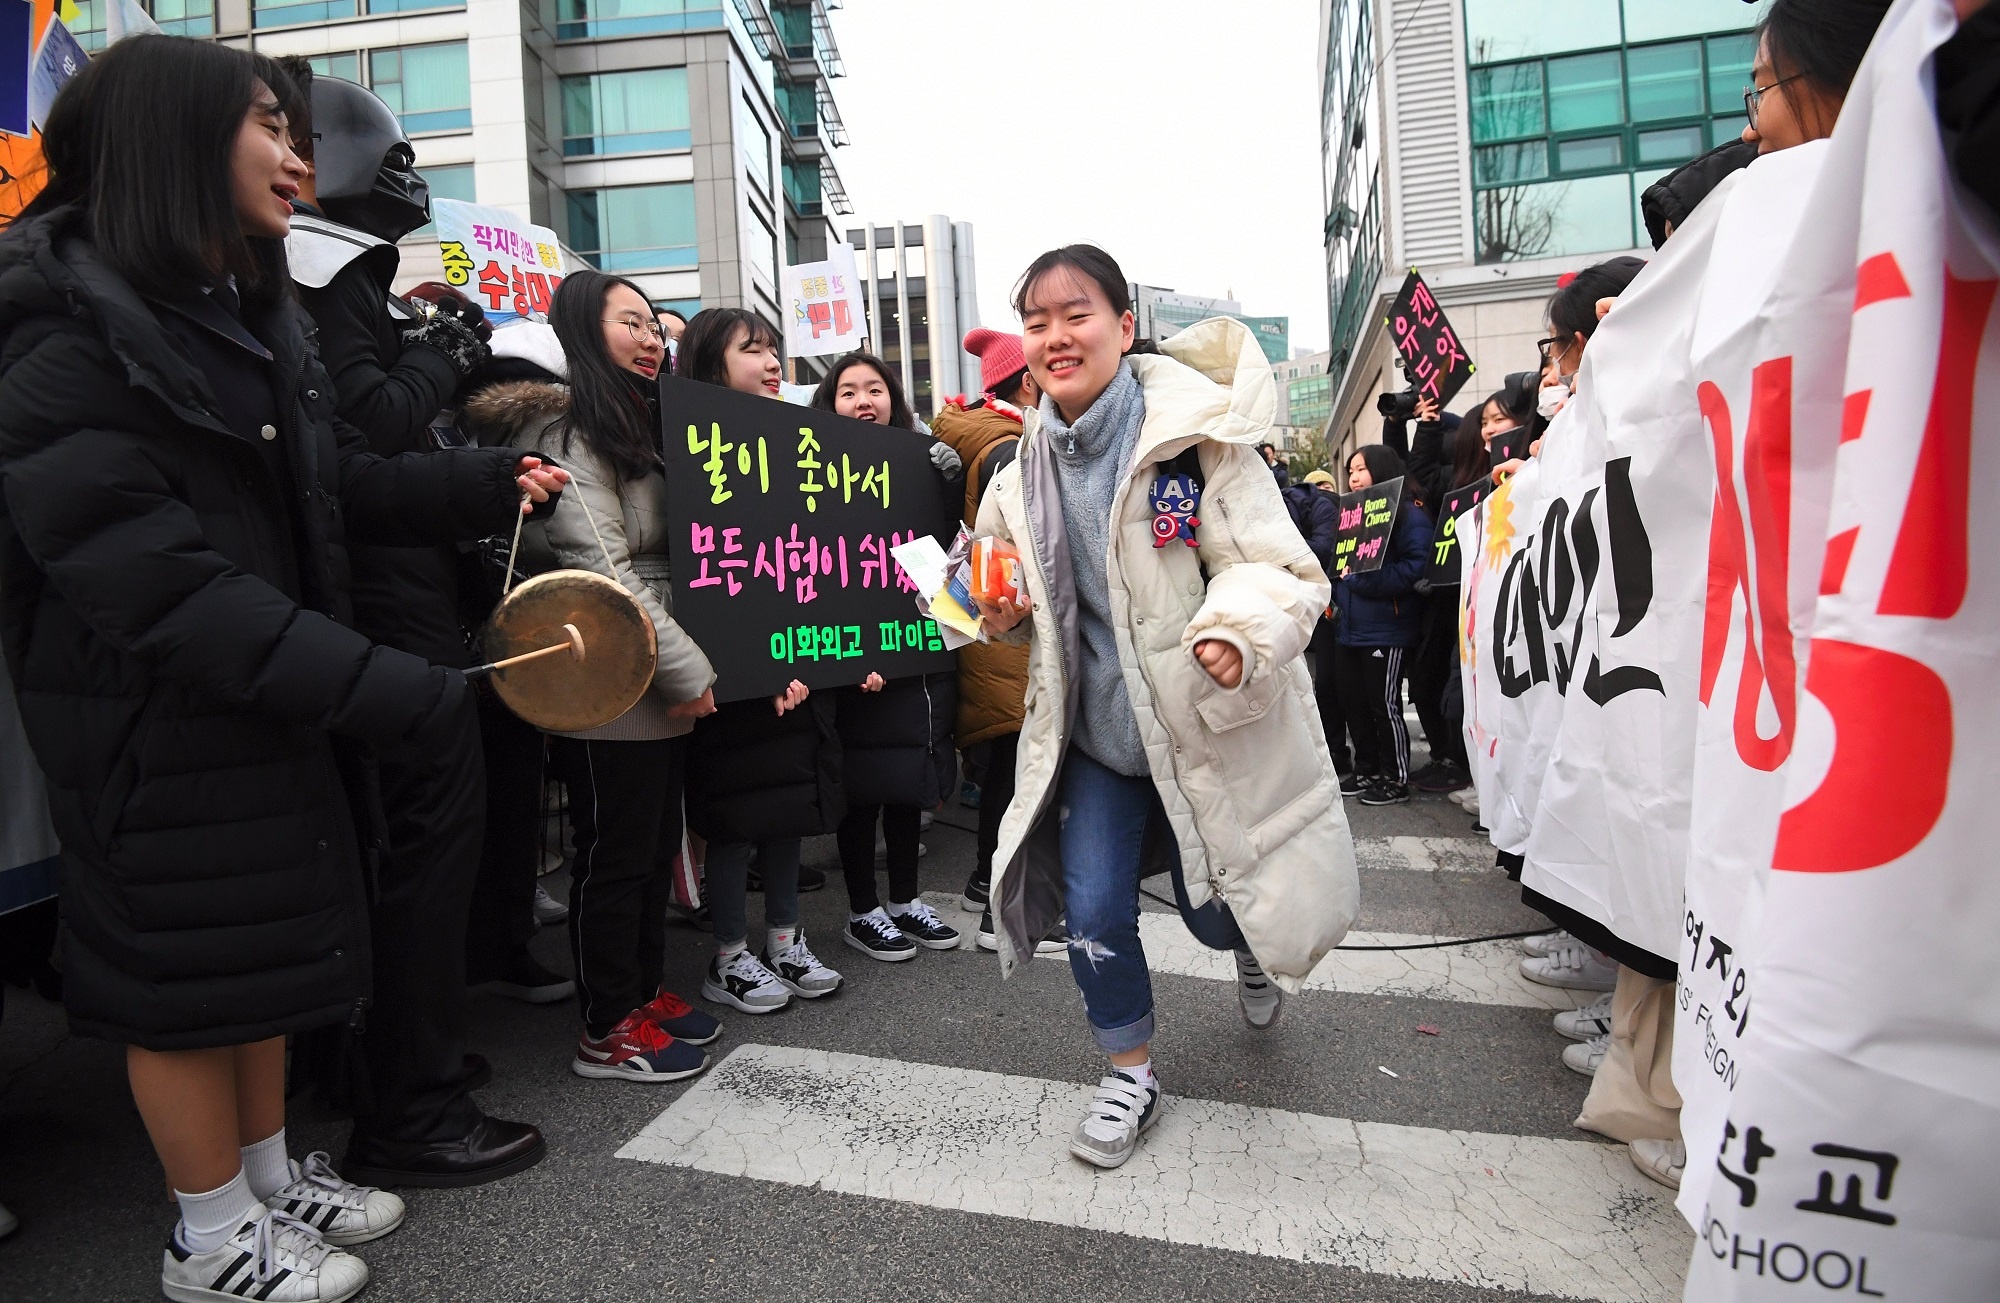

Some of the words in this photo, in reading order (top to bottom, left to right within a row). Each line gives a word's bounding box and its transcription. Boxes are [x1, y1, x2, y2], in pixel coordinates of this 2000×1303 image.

[440, 241, 475, 286] 중
[478, 260, 563, 316] 수능대
[687, 422, 770, 505] 날이
[796, 427, 890, 513] 좋아서
[1364, 497, 1388, 515] Bonne
[1365, 510, 1392, 528] Chance
[770, 626, 864, 664] 이화외고
[878, 619, 943, 652] 파이팅
[620, 1042, 641, 1052] Reebok
